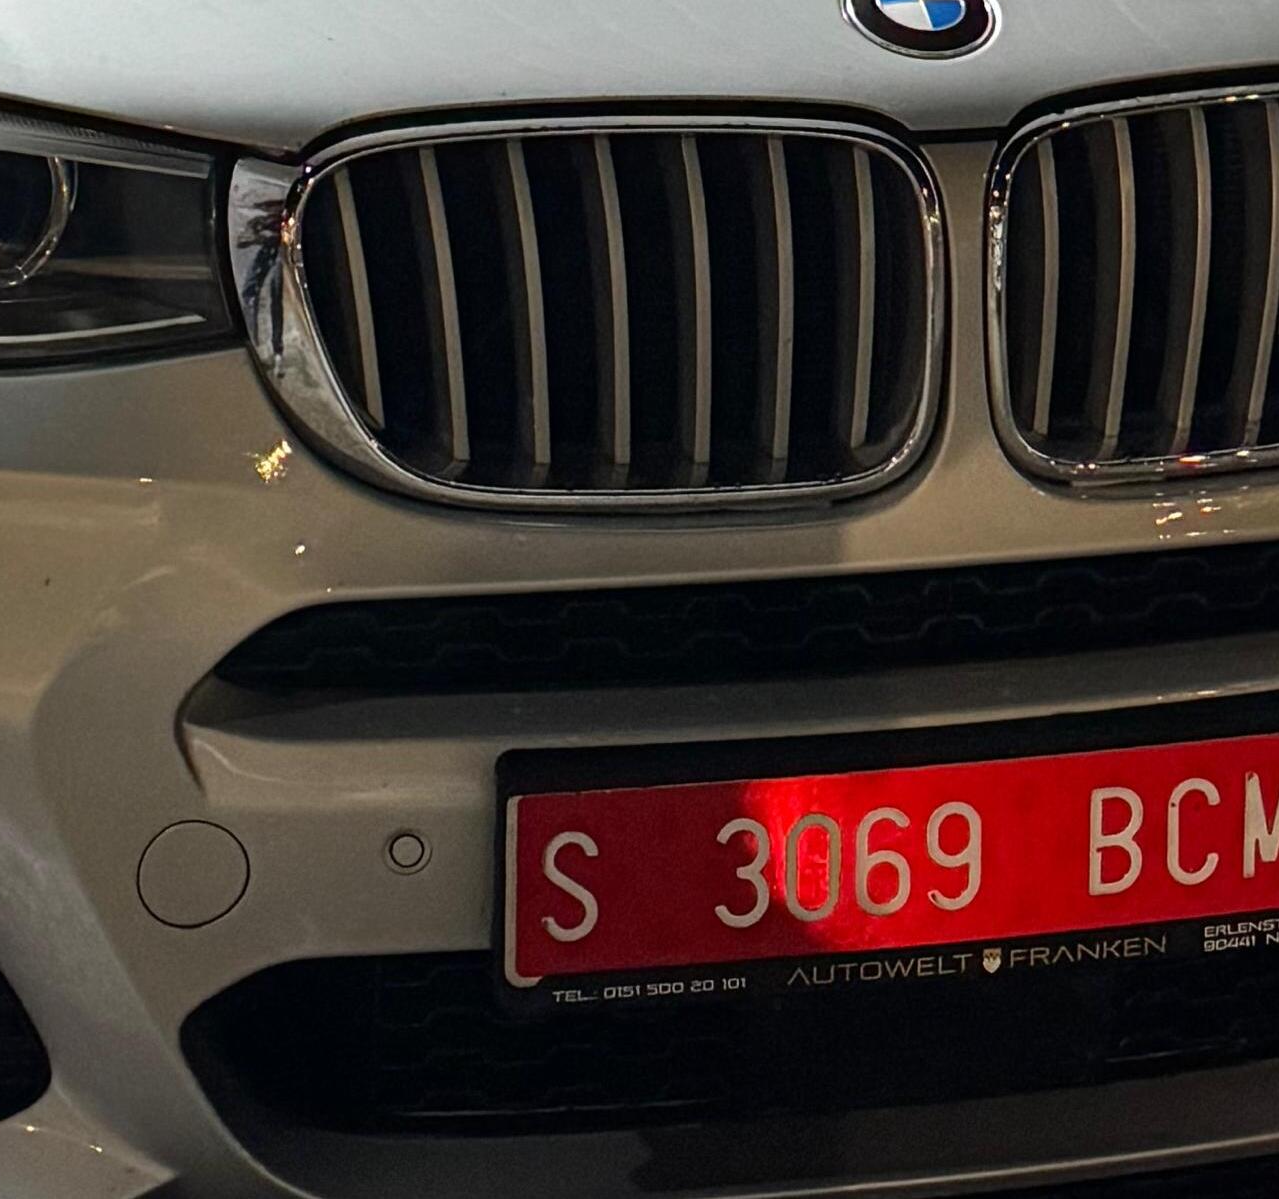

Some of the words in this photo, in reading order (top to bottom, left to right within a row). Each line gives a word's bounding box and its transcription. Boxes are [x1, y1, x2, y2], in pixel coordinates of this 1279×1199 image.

[542, 831, 599, 942] S
[714, 801, 982, 928] 3069
[787, 953, 973, 987] AUTOWELT
[1009, 935, 1168, 968] FRANKEN
[1203, 936, 1256, 952] 90441
[690, 979, 715, 992] 20
[722, 977, 747, 991] 101
